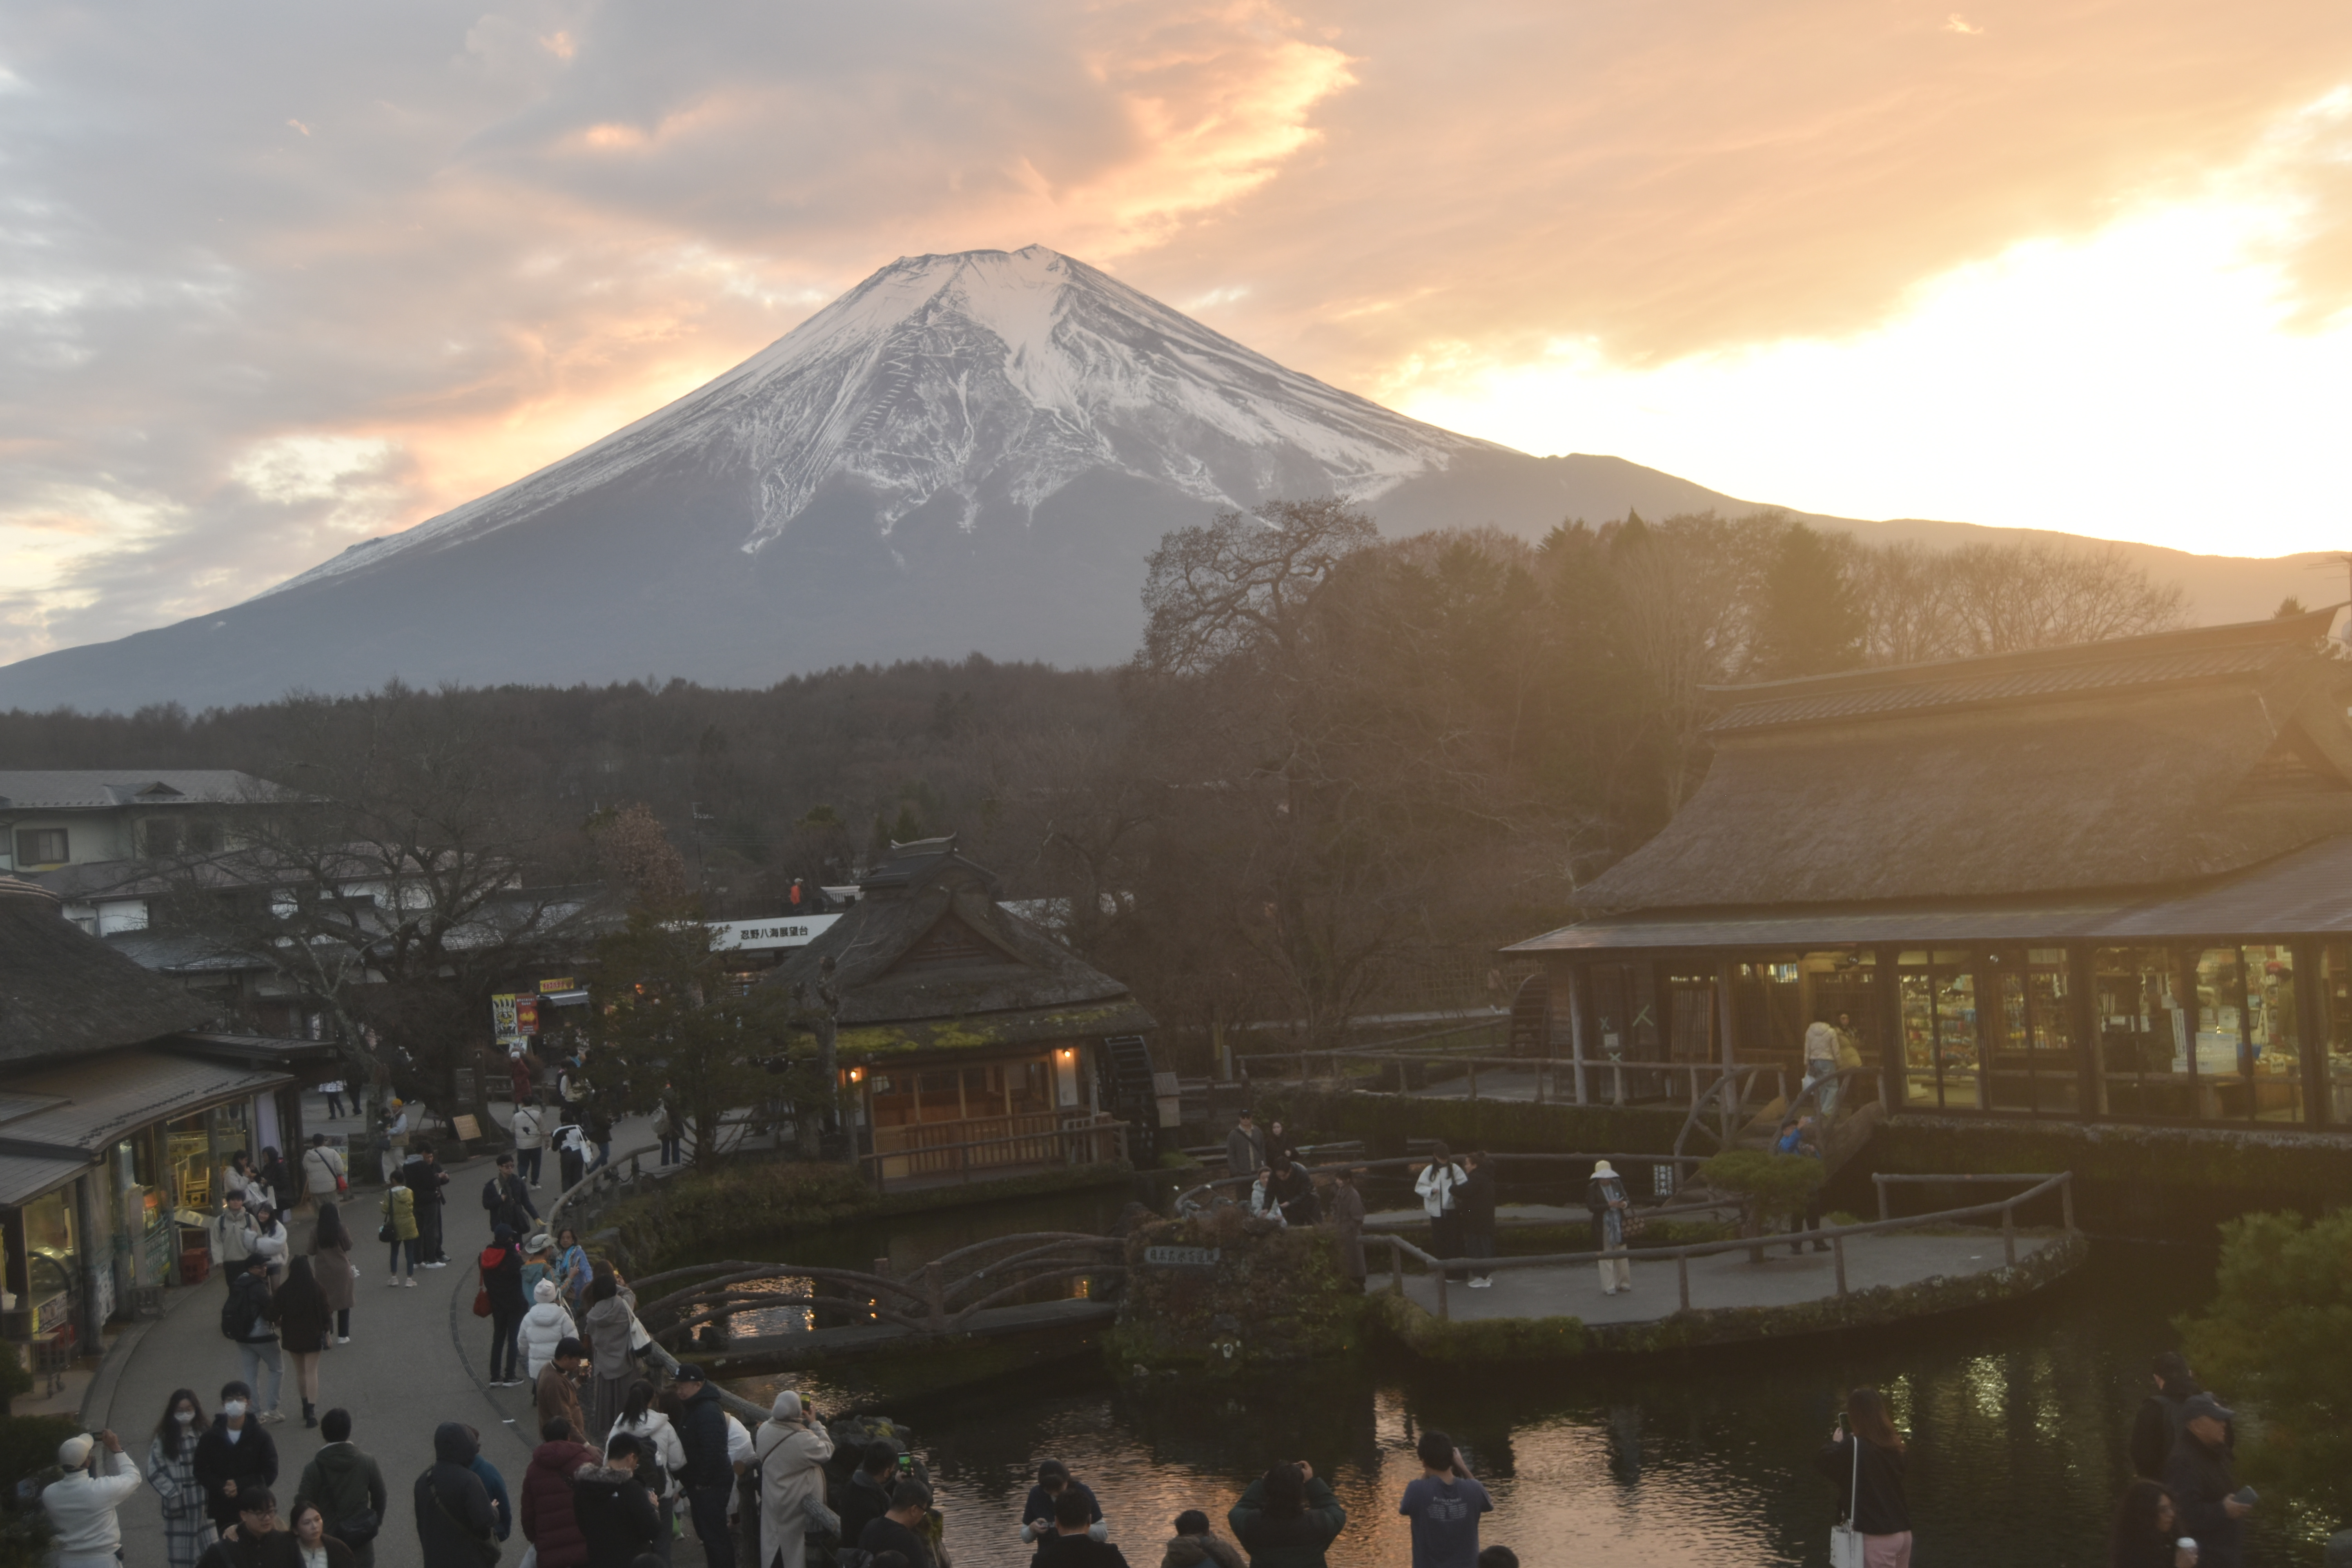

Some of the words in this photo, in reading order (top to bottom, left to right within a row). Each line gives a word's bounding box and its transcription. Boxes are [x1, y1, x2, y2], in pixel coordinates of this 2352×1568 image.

[740, 926, 808, 940] 忍野八海展望台
